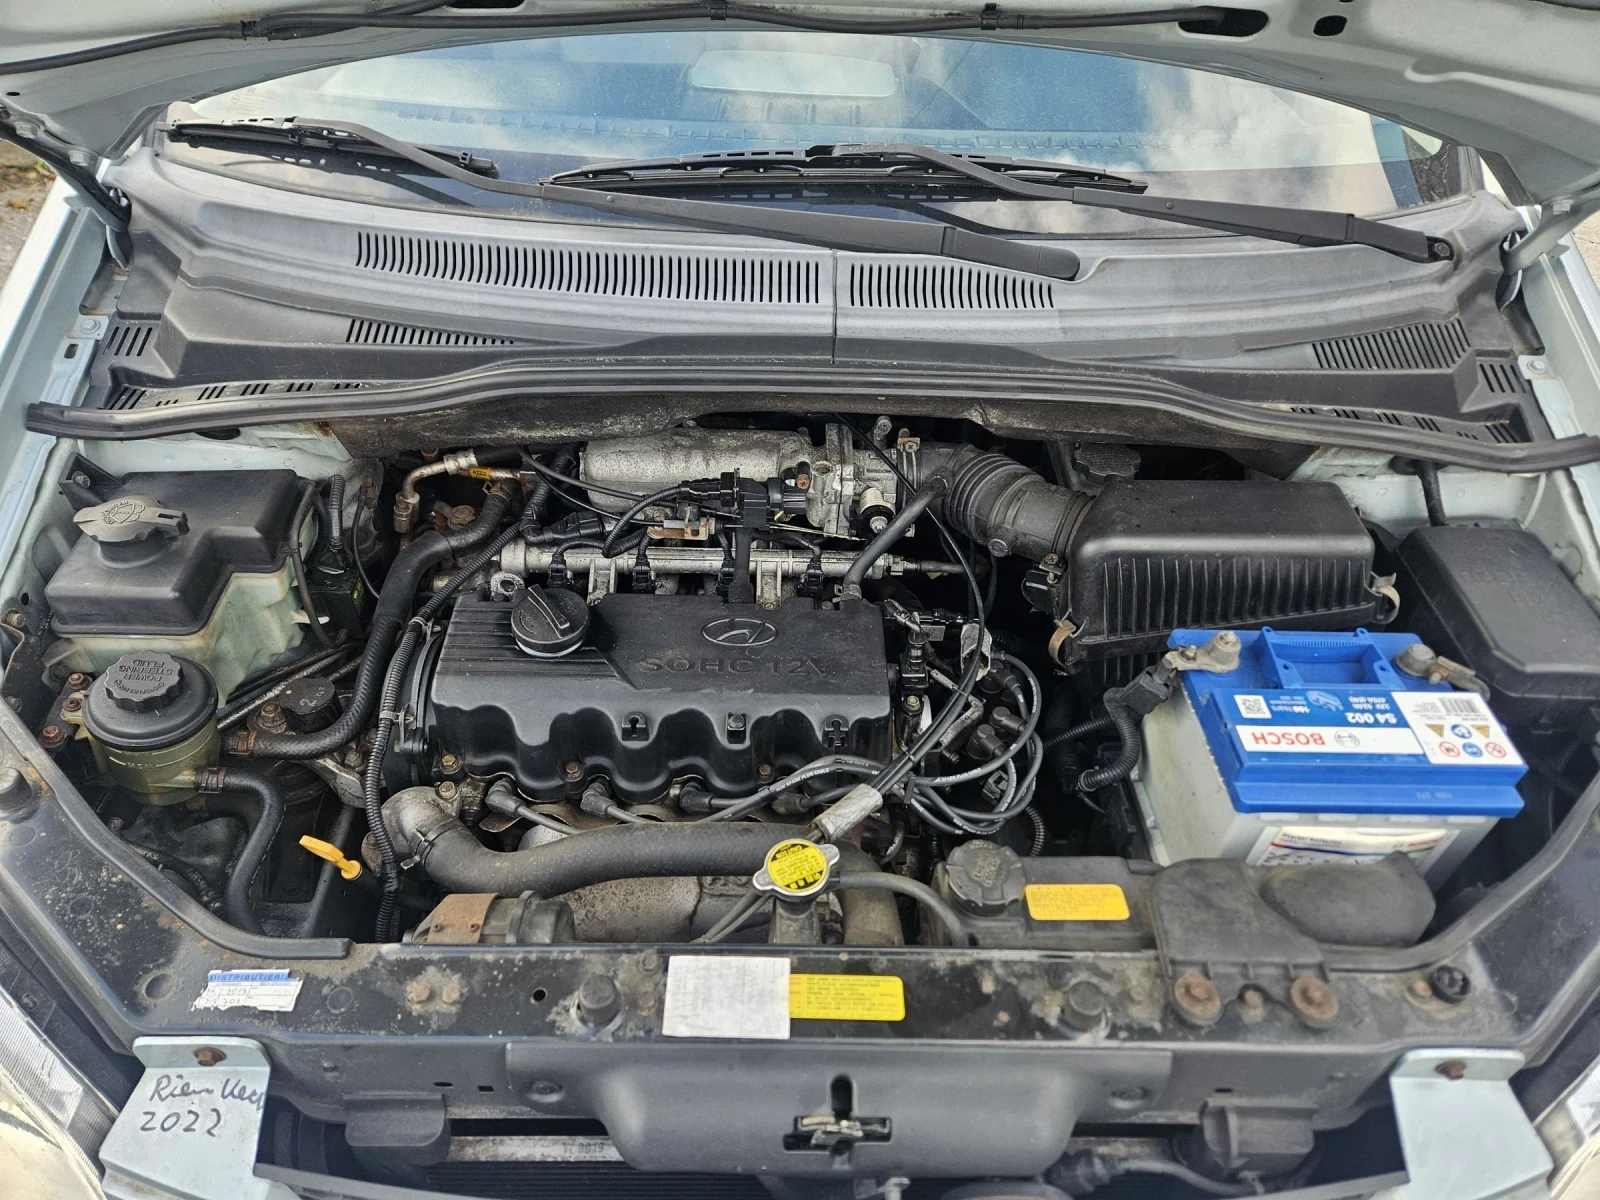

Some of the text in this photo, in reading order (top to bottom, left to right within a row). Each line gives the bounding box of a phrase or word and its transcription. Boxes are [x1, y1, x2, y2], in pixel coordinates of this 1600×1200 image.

[132, 659, 165, 669] FLUID
[638, 657, 836, 677] SOHC 12V
[118, 665, 174, 677] STEERING
[122, 673, 163, 683] POWER
[1344, 712, 1375, 725] 002
[1374, 712, 1398, 725] S4
[1251, 731, 1327, 746] BOSCH
[139, 1107, 223, 1138] 2022
